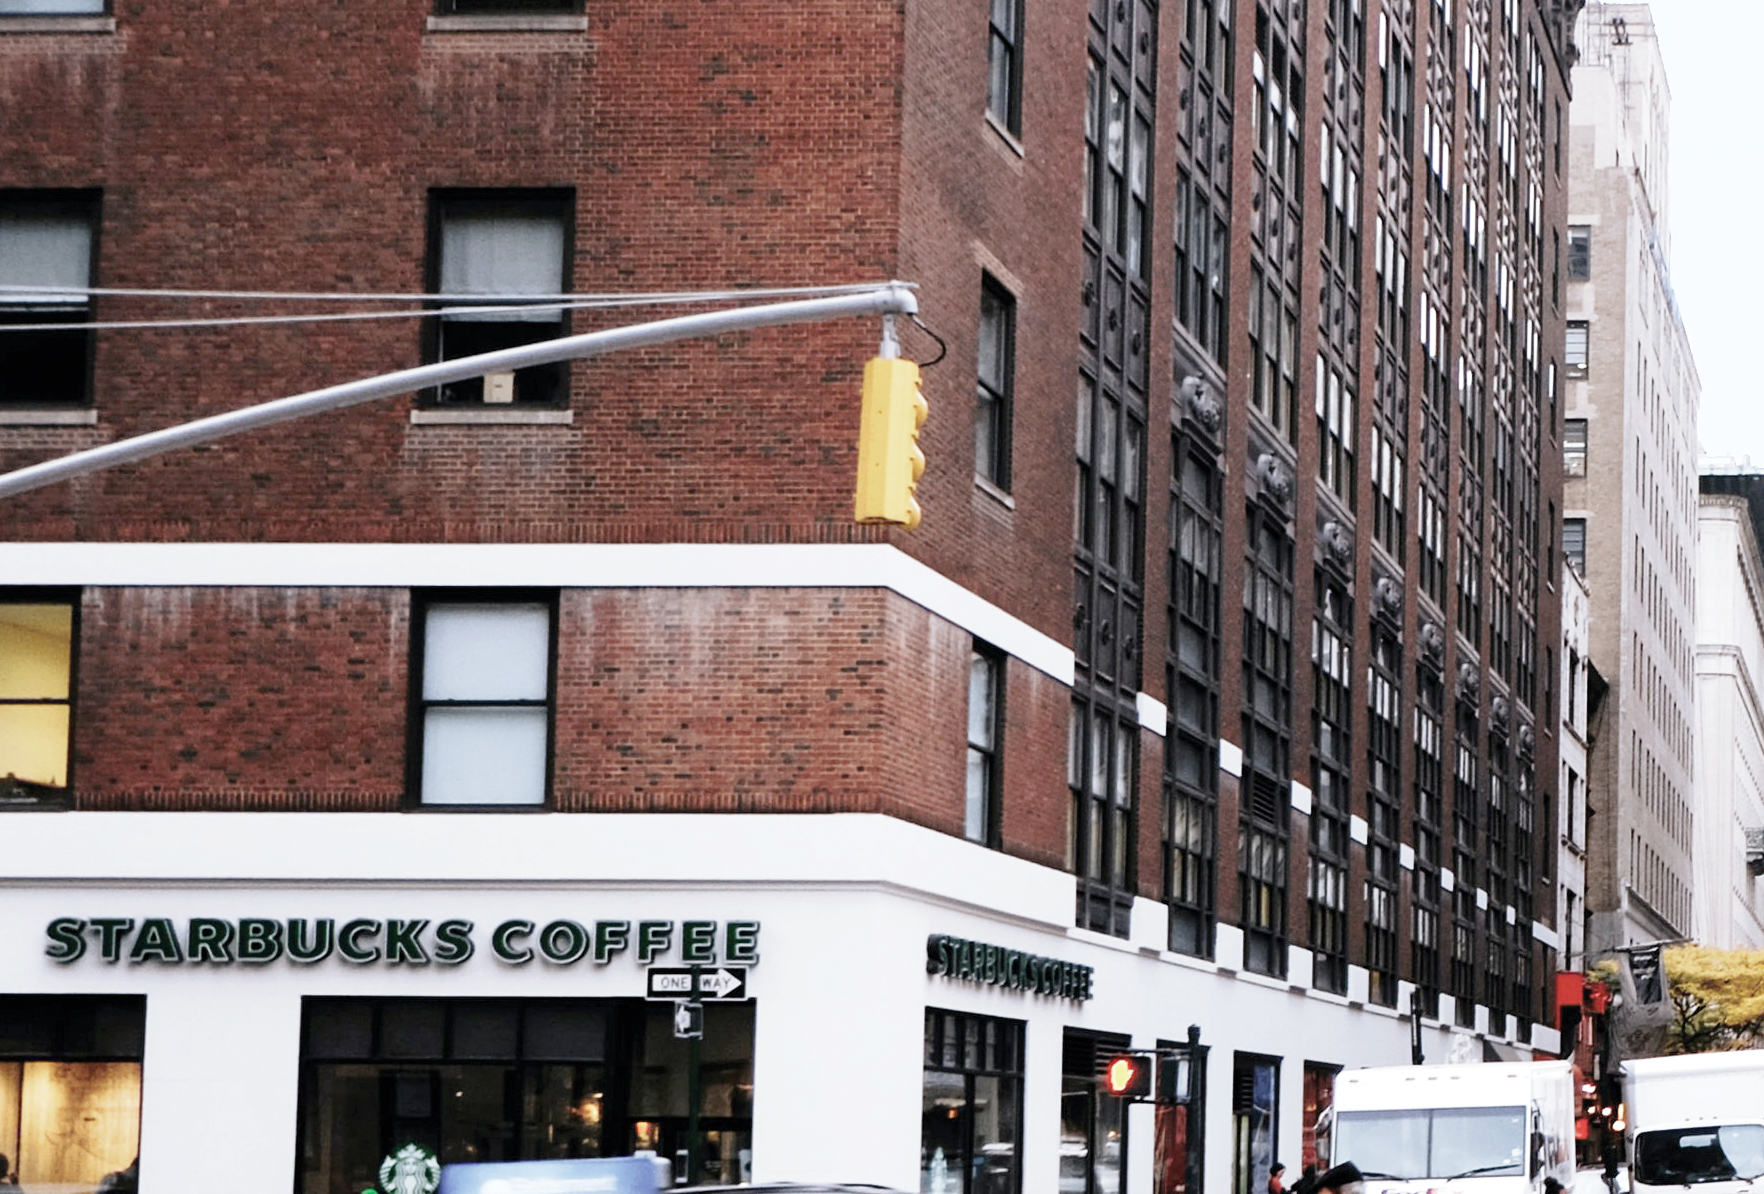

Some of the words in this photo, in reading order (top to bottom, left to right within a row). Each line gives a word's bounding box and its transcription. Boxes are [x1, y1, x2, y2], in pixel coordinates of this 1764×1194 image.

[45, 917, 475, 965] STARBUCKS
[491, 919, 760, 965] COFFEE
[661, 976, 690, 989] ONE
[702, 976, 732, 989] WAY
[927, 934, 1038, 994] STARBUCKS
[1039, 956, 1094, 1001] COFFEE
